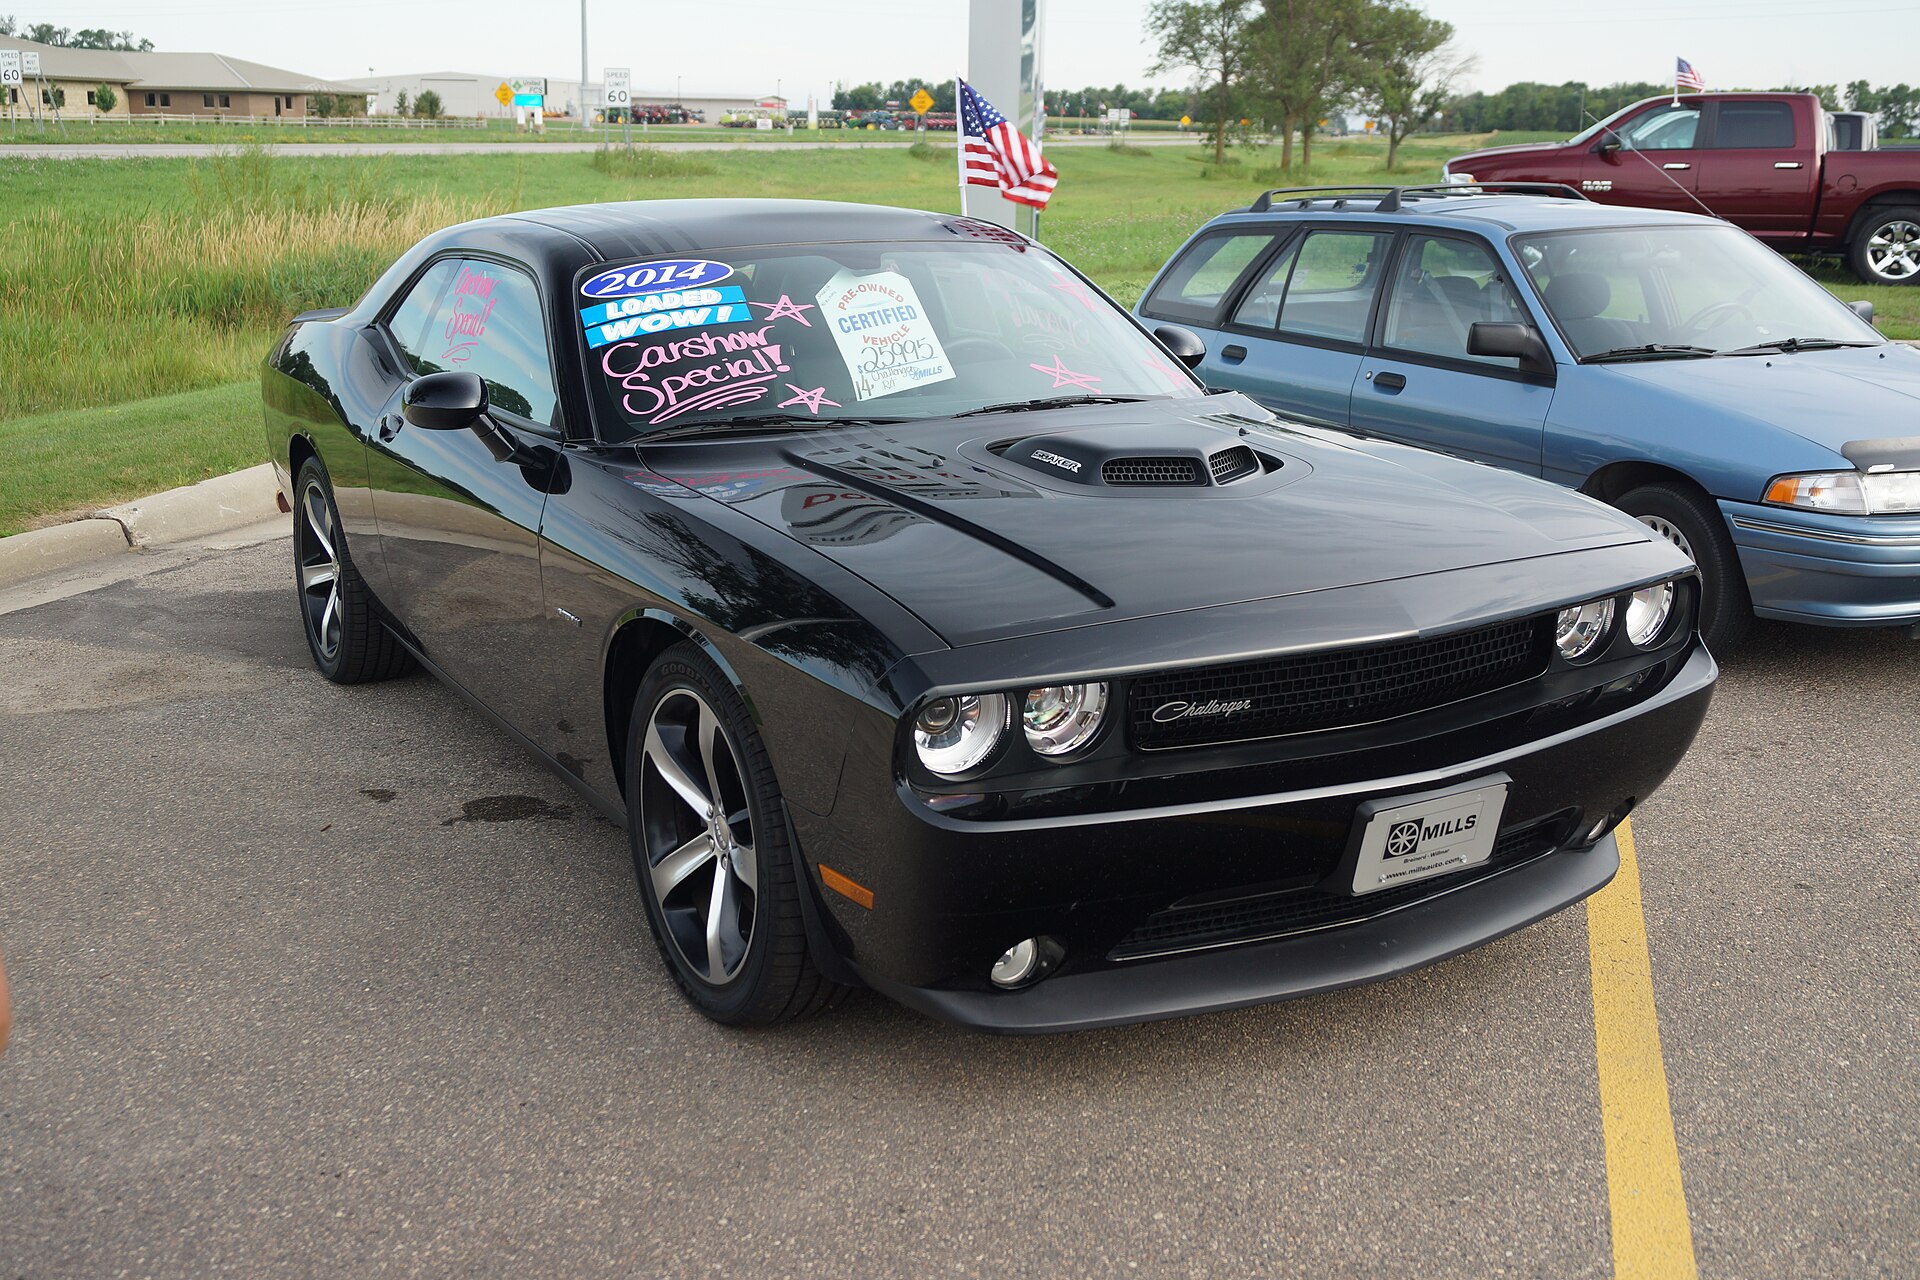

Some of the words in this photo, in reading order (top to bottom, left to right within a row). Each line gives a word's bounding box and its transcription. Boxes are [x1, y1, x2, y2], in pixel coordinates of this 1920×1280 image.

[4, 70, 19, 80] 60
[608, 90, 627, 102] 60
[596, 262, 708, 295] 2014
[606, 288, 722, 320] LOADED
[838, 283, 904, 311] PRE-OWNED
[838, 305, 918, 334] CERTIFIED
[862, 324, 910, 346] VEHICLE
[622, 344, 791, 415] Special!
[918, 366, 943, 378] MILLS
[1031, 449, 1082, 473] SHAKER
[1152, 699, 1251, 722] Challenger
[1421, 814, 1477, 841] MILLS
[1386, 856, 1461, 880] www.millsauto.com
